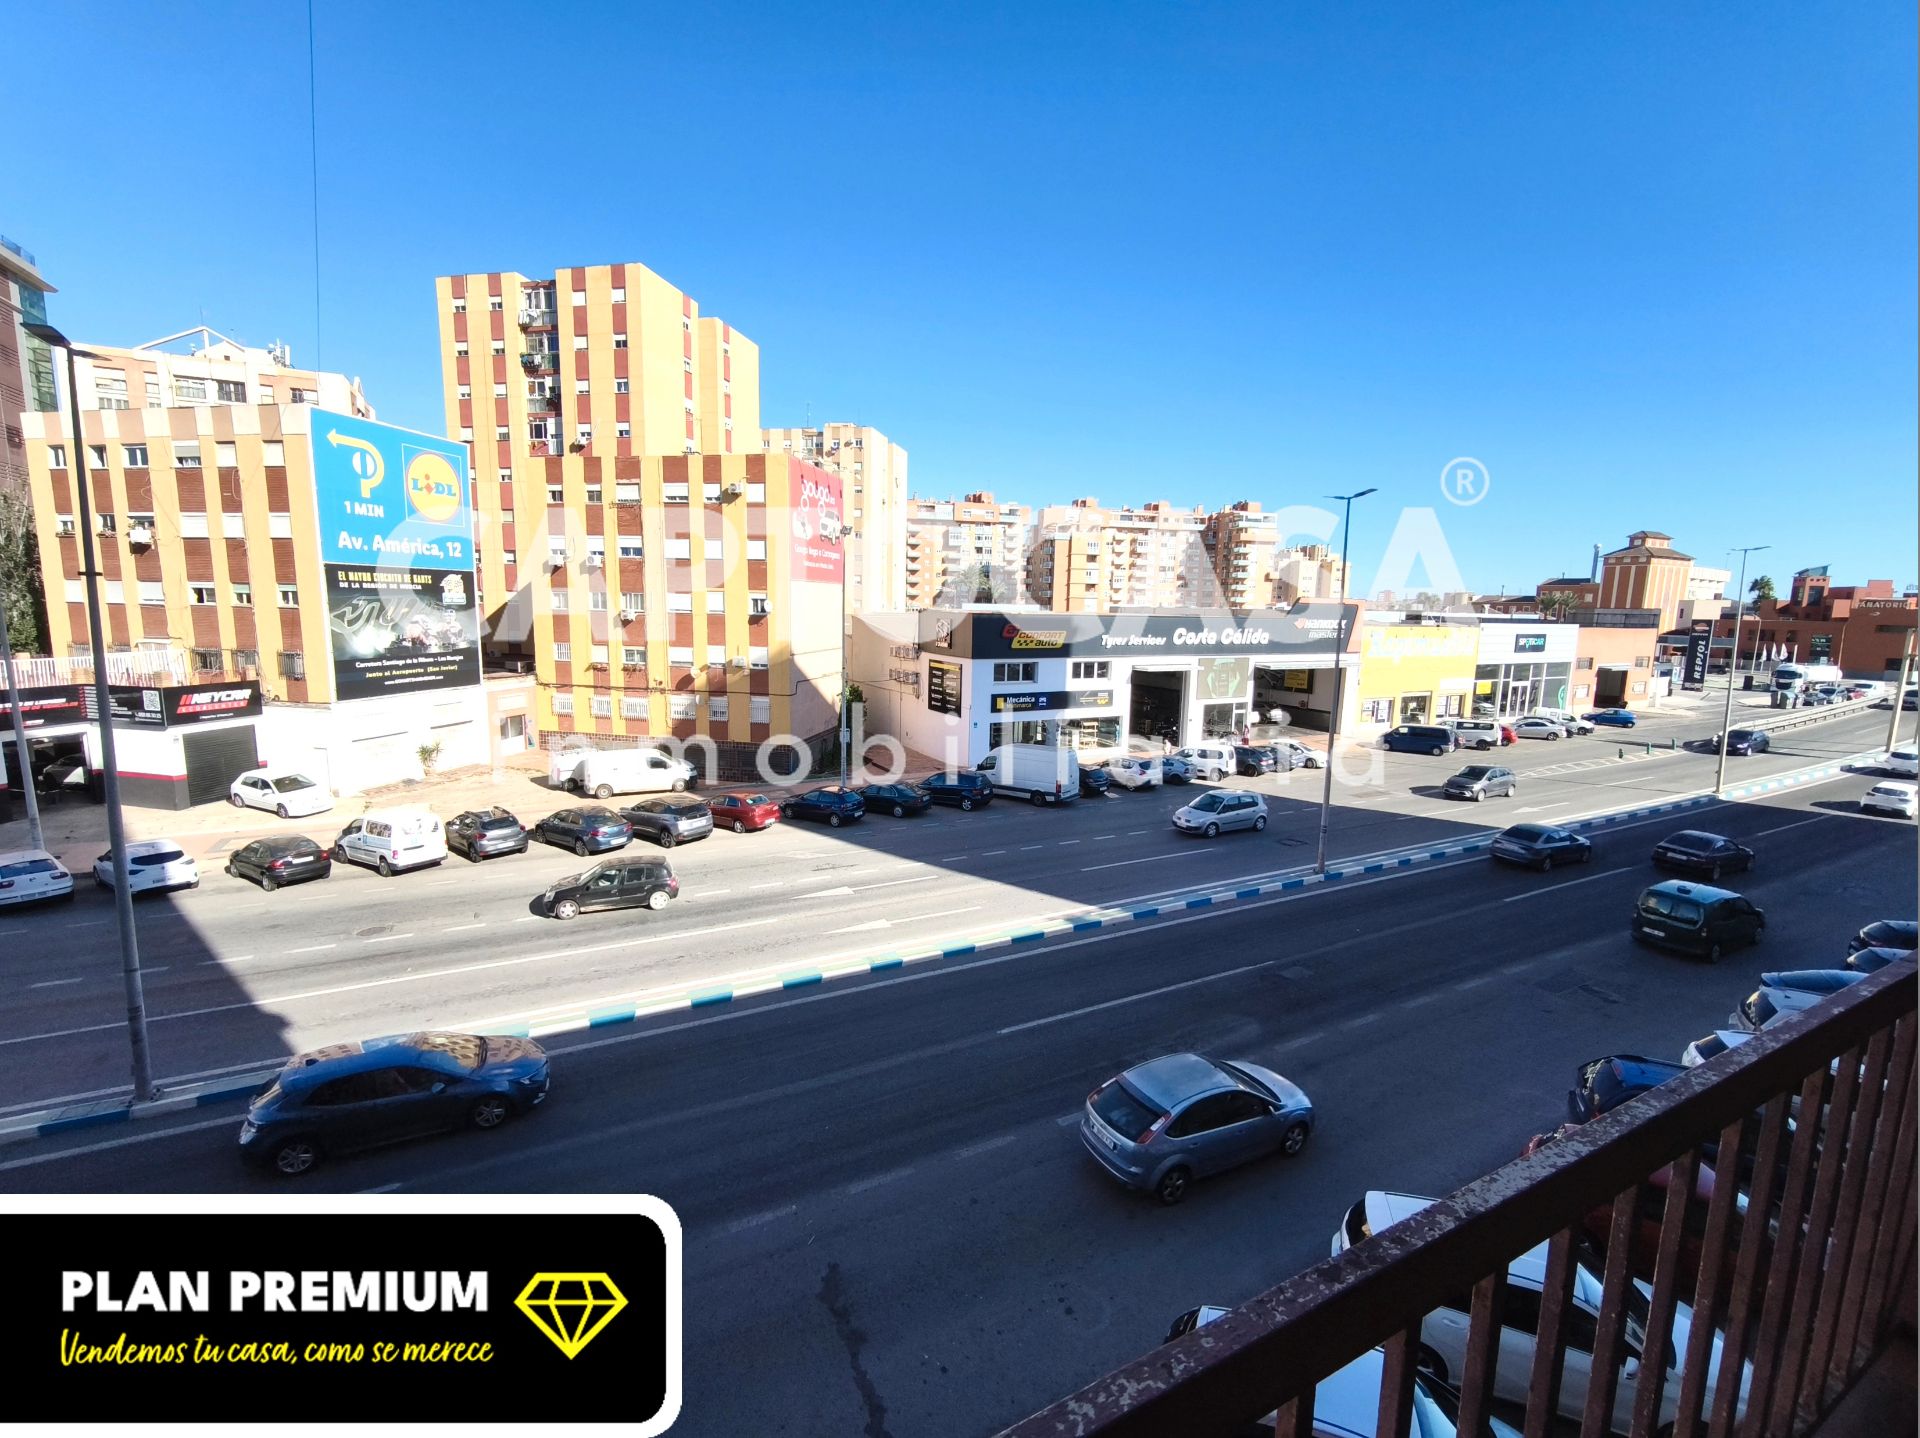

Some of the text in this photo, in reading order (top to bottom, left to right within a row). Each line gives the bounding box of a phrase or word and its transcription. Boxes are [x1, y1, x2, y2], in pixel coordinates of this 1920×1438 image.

[411, 473, 456, 496] LIDL
[344, 501, 384, 518] 1 MIN
[338, 530, 463, 559] Av. América, 12
[338, 571, 347, 581] EL
[404, 574, 412, 583] DE
[1853, 600, 1910, 609] TANATORIO
[1035, 639, 1058, 647] auto
[1128, 634, 1167, 646] Services
[1172, 627, 1218, 646] Costa
[1220, 627, 1270, 645] Cálida
[1693, 639, 1706, 679] REPSOL
[366, 671, 383, 679] Junto
[1006, 696, 1036, 704] Mecánica
